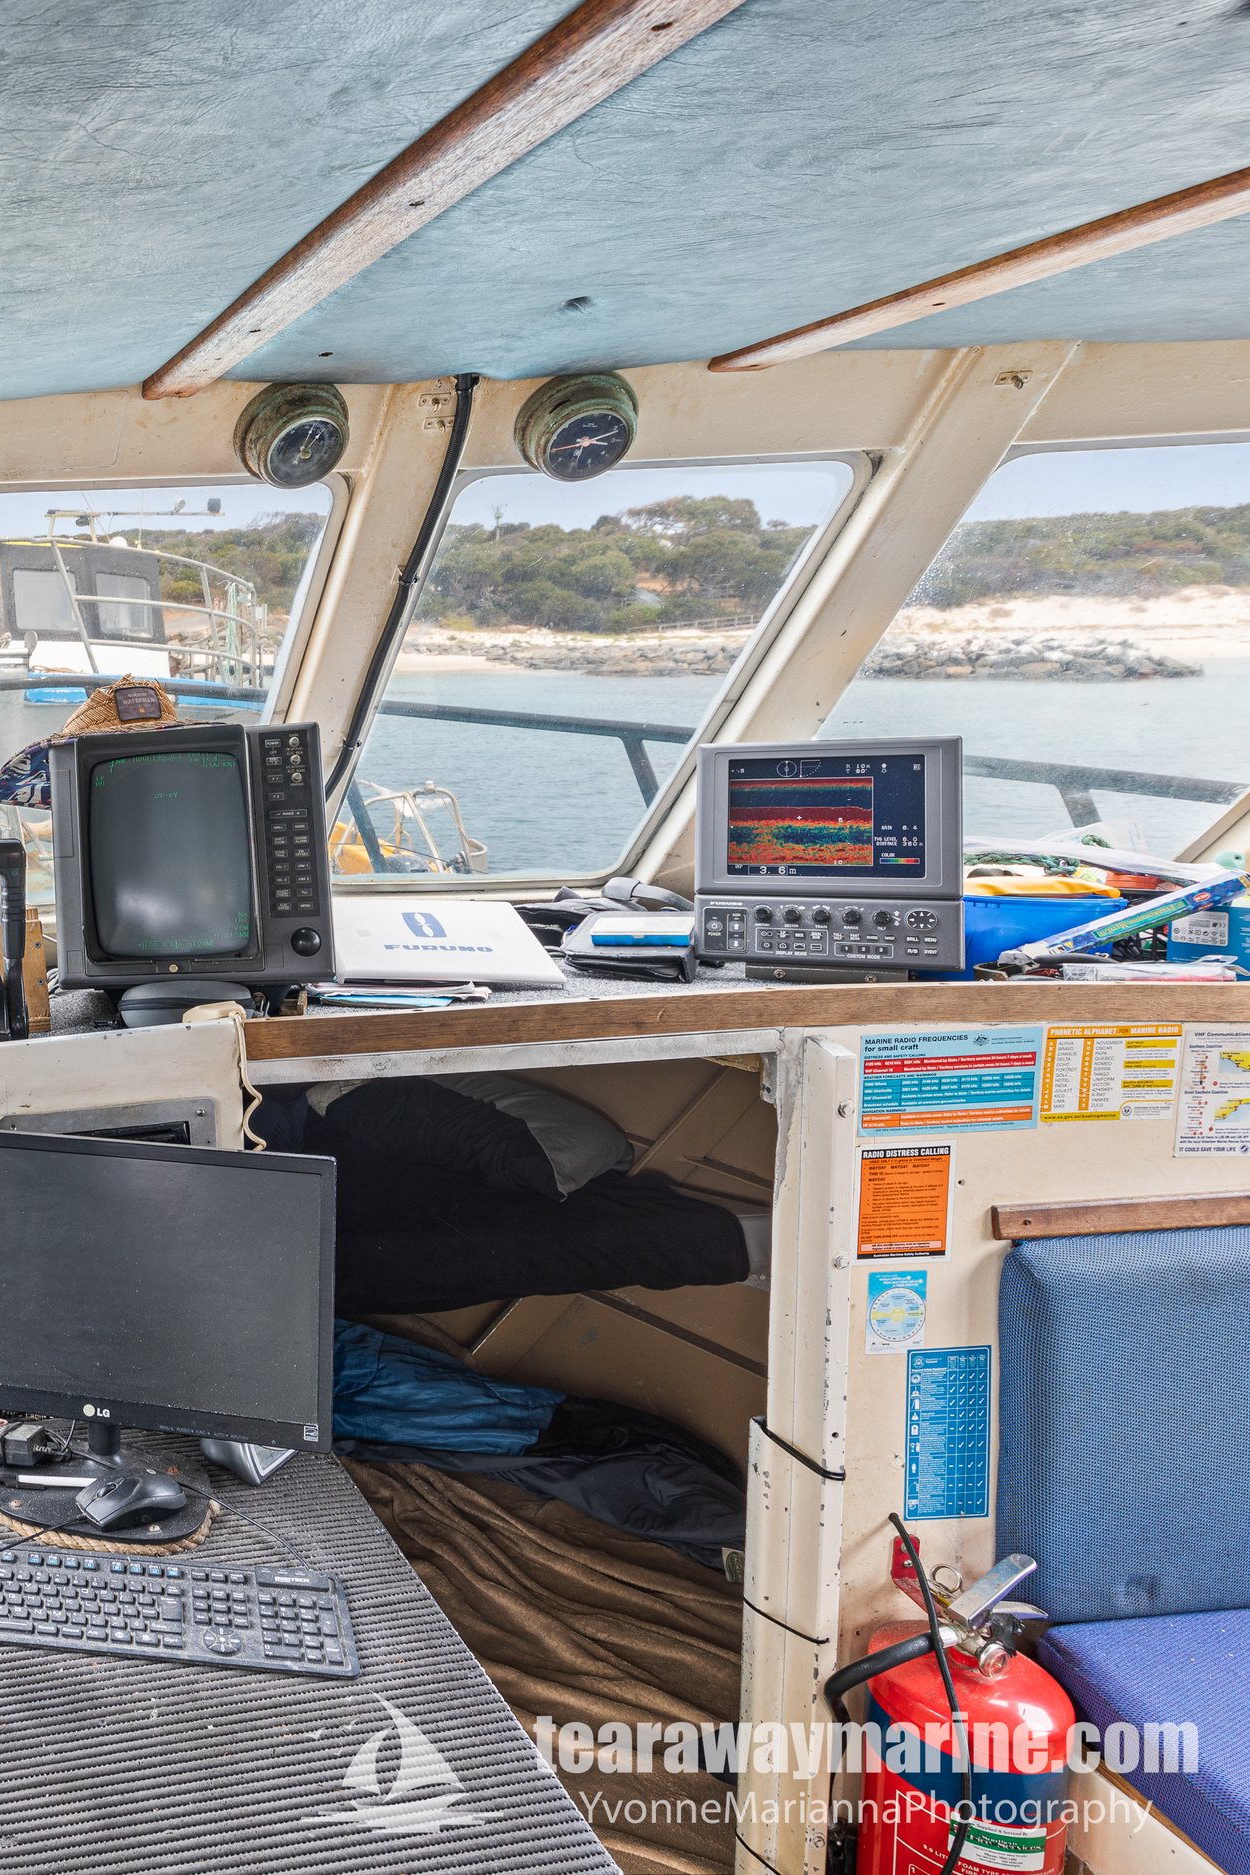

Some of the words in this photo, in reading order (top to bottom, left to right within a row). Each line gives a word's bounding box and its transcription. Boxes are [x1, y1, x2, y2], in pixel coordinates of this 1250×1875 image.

[918, 1035, 968, 1043] FREQUENCIES
[863, 1151, 884, 1159] RADIO
[921, 1147, 949, 1155] CALLING
[97, 1408, 110, 1417] LG
[977, 1824, 997, 1832] Supplied
[970, 1835, 992, 1845] Fire
[998, 1842, 1042, 1851] Services
[958, 1861, 980, 1872] FOAM
